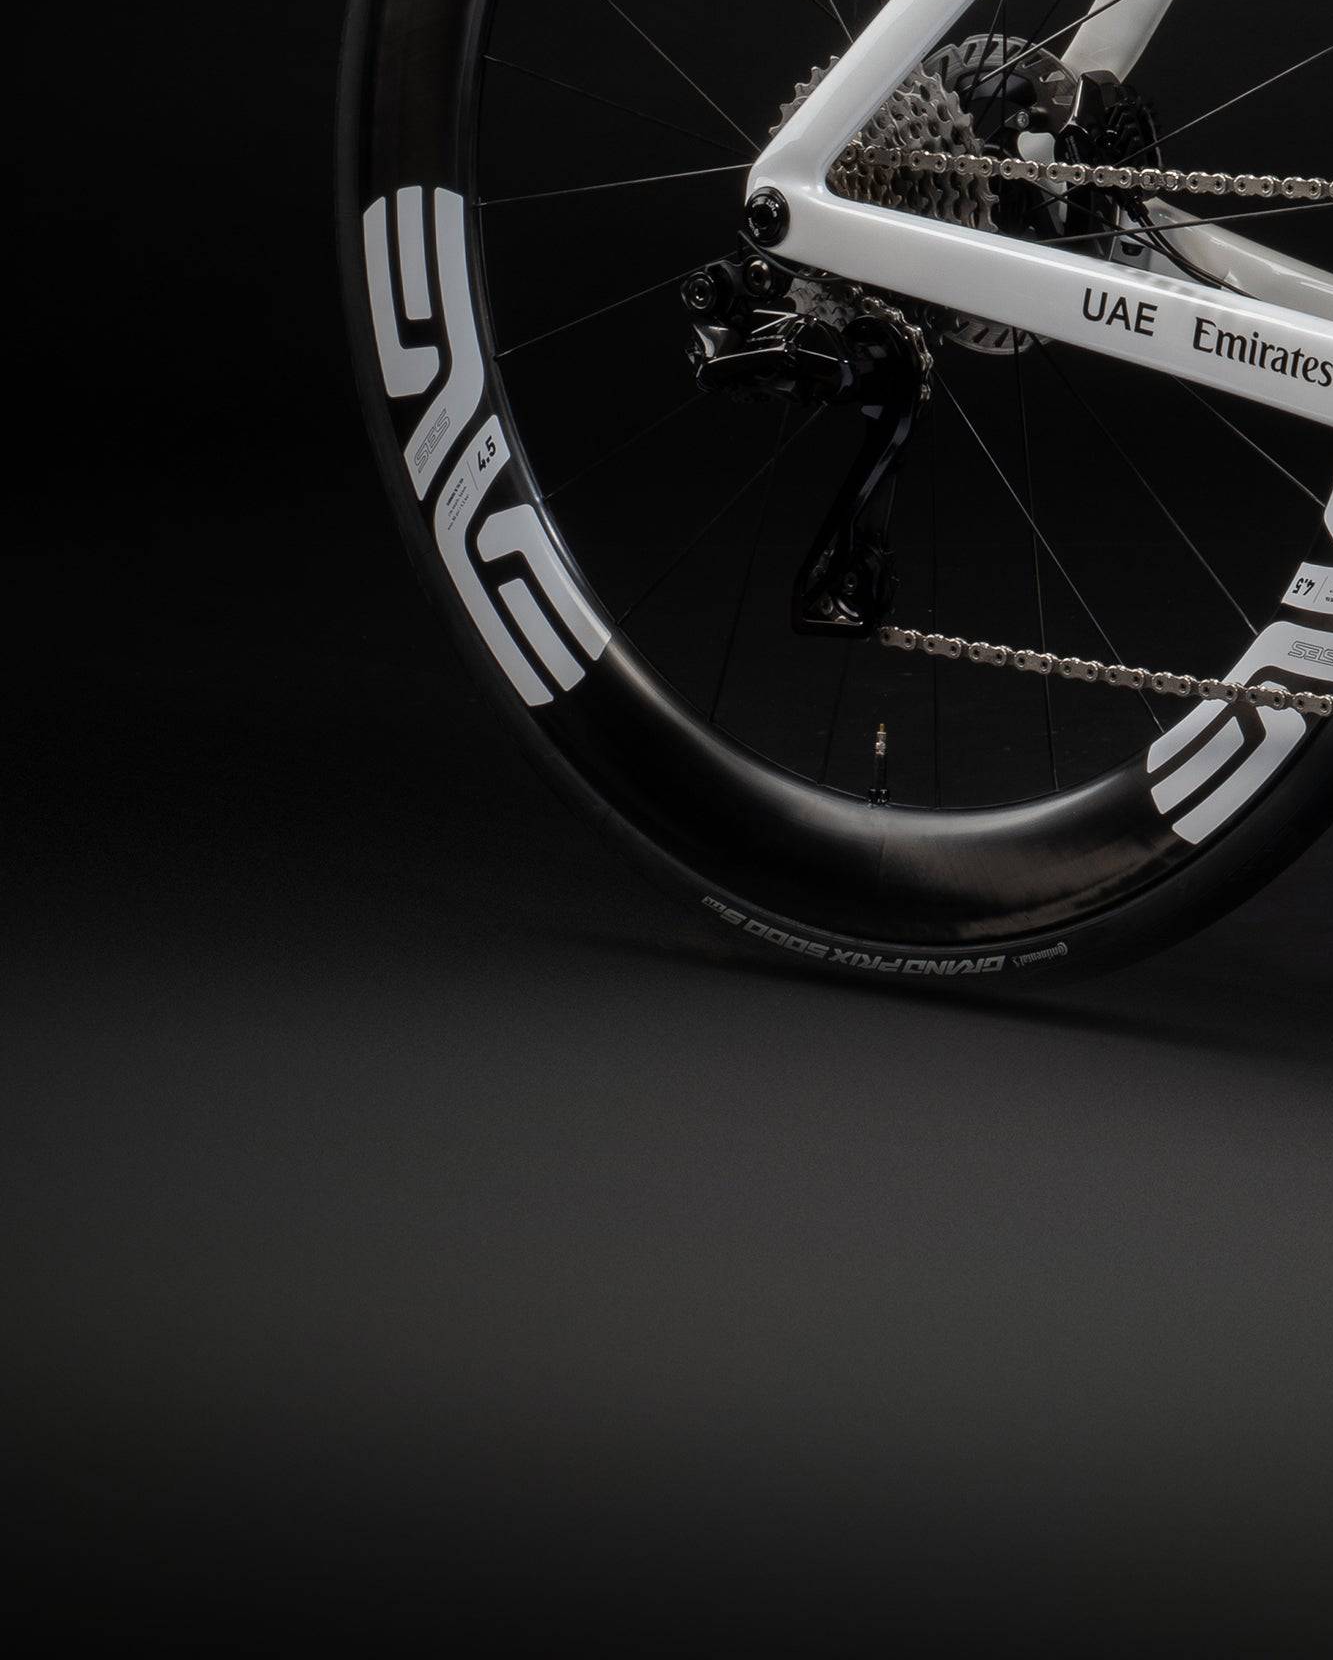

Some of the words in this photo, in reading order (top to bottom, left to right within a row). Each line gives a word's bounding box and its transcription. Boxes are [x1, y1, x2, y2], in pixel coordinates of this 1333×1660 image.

[1082, 288, 1158, 338] UAE
[1193, 316, 1333, 388] Emirates
[477, 435, 496, 472] 4.5
[1292, 577, 1316, 596] 4.5
[744, 922, 831, 959] 5000
[829, 947, 903, 974] PRIX
[901, 954, 1007, 976] GRAND
